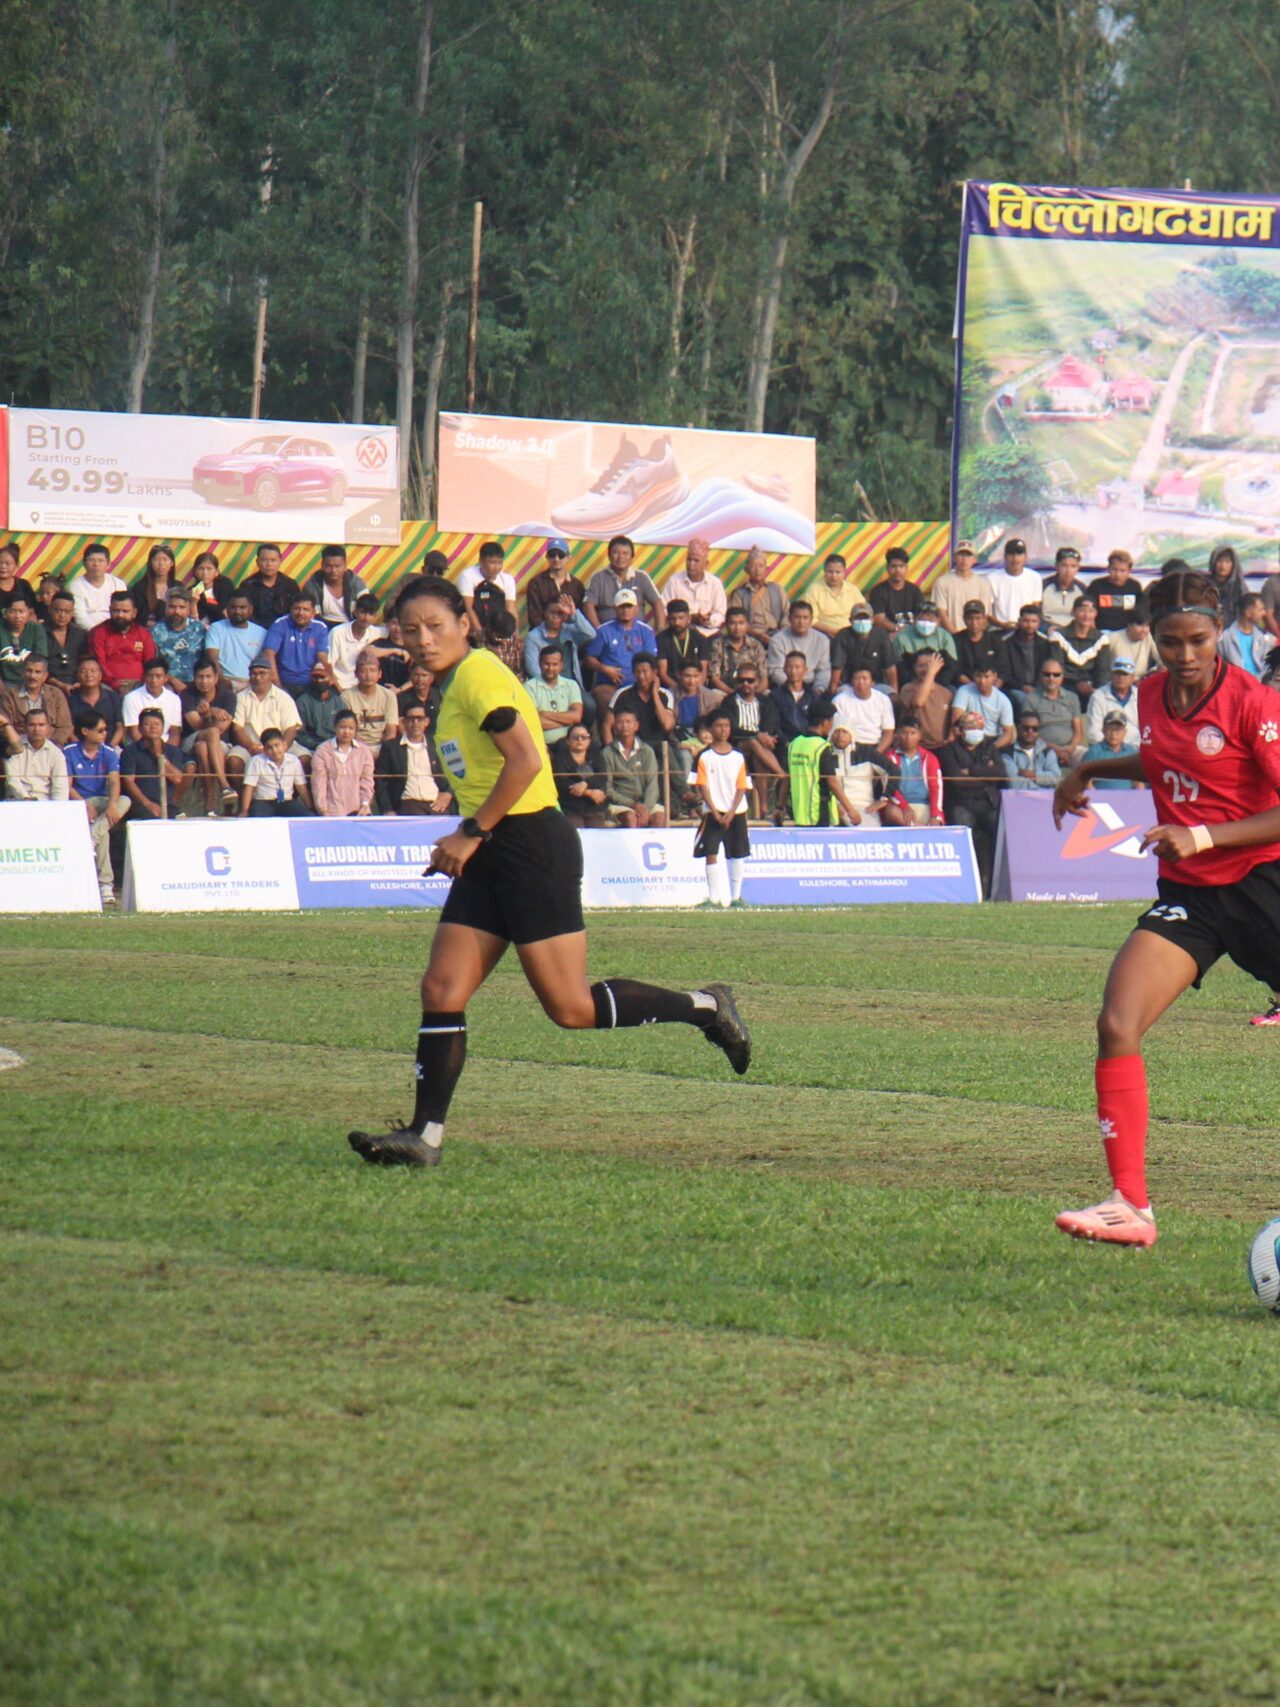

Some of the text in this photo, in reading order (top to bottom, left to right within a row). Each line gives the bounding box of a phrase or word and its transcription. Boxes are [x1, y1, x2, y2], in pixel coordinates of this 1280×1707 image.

[27, 425, 85, 451] B10
[455, 431, 524, 451] Shadow
[28, 452, 118, 466] Starting From
[127, 484, 172, 496] Lakhs
[1163, 769, 1199, 803] 29
[305, 845, 397, 864] CHAUDHARY
[746, 843, 824, 860] HAUDHARY
[828, 843, 894, 860] TRADERS
[161, 879, 280, 891] CHAUDHARY TRADERS
[601, 876, 664, 884] CHAUDHARY
[852, 879, 908, 887] KATHMANDU
